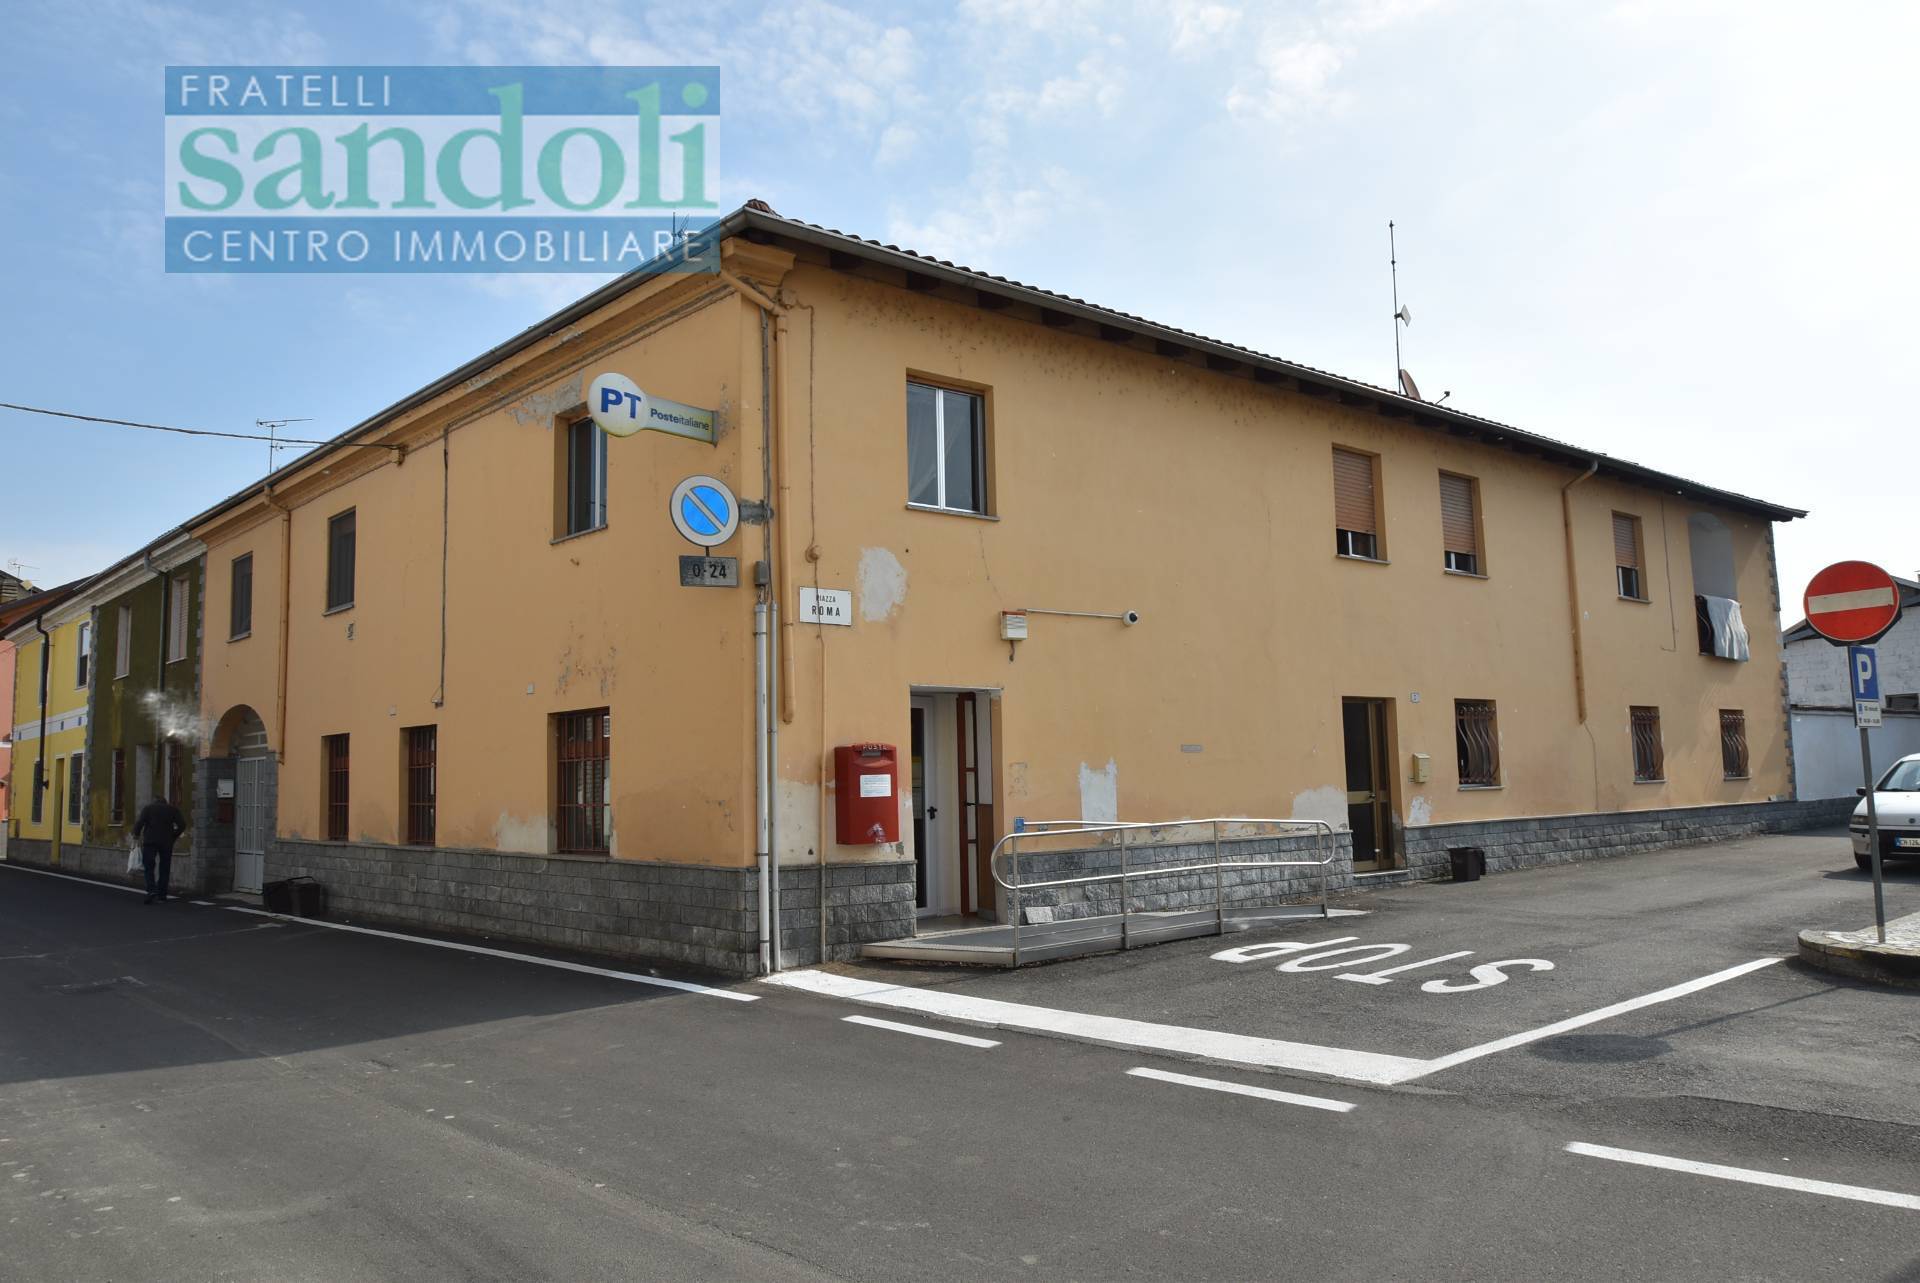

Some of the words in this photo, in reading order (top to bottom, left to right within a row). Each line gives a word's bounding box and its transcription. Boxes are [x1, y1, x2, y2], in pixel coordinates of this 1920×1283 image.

[600, 387, 642, 419] PT
[811, 605, 841, 617] ROMA
[816, 595, 836, 603] PIAZZA
[1855, 653, 1873, 694] P
[1209, 936, 1555, 994] STOP
